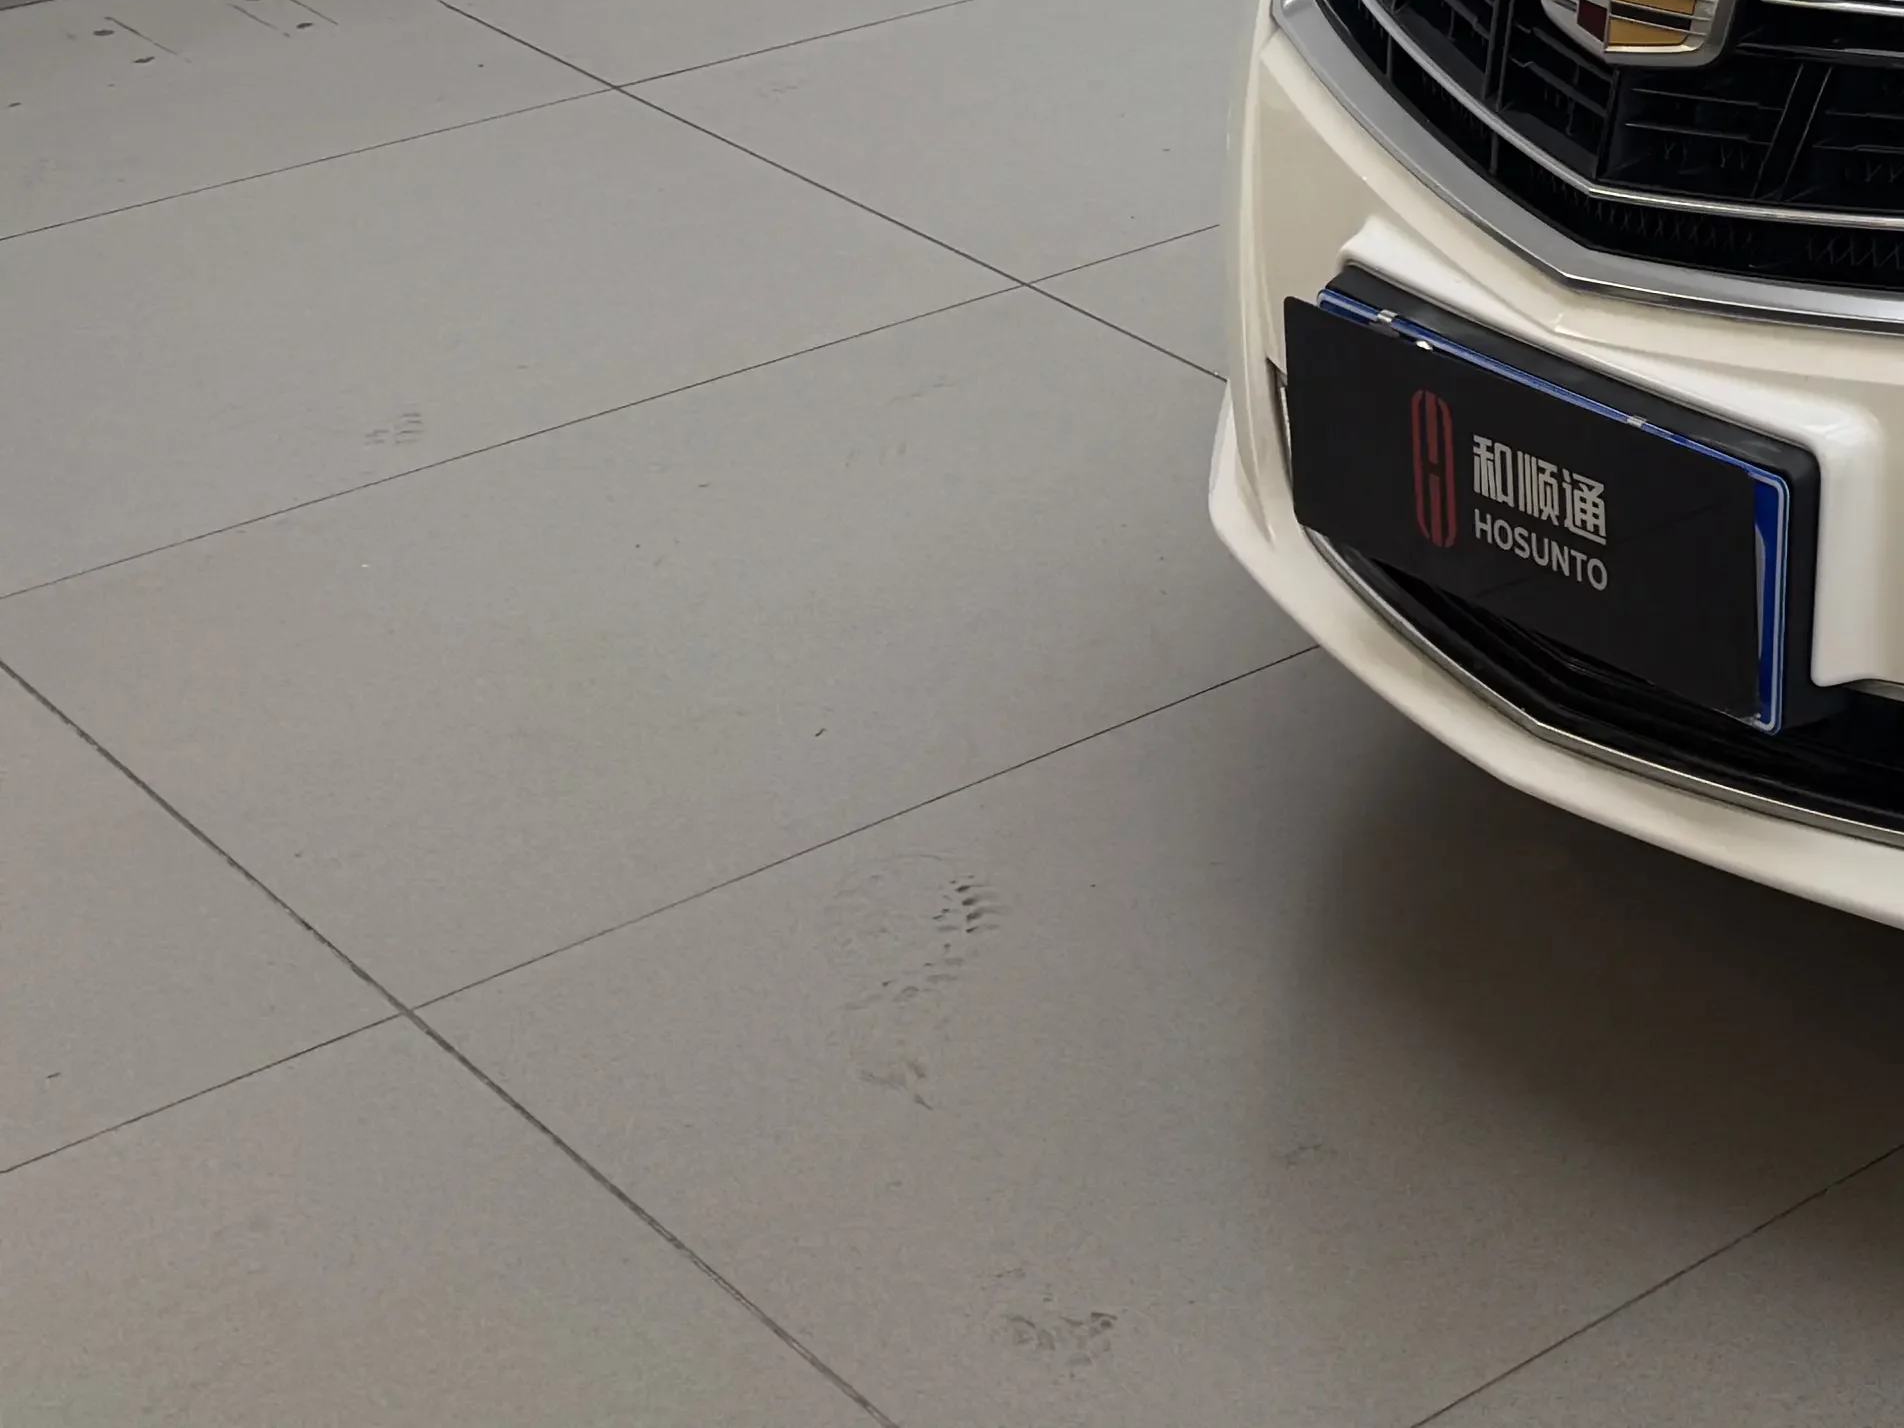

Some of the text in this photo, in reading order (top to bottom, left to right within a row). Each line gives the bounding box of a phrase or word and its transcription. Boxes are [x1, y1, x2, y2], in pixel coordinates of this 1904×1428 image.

[1472, 434, 1607, 546] 和顺通
[1474, 508, 1608, 592] HOSUNTO
